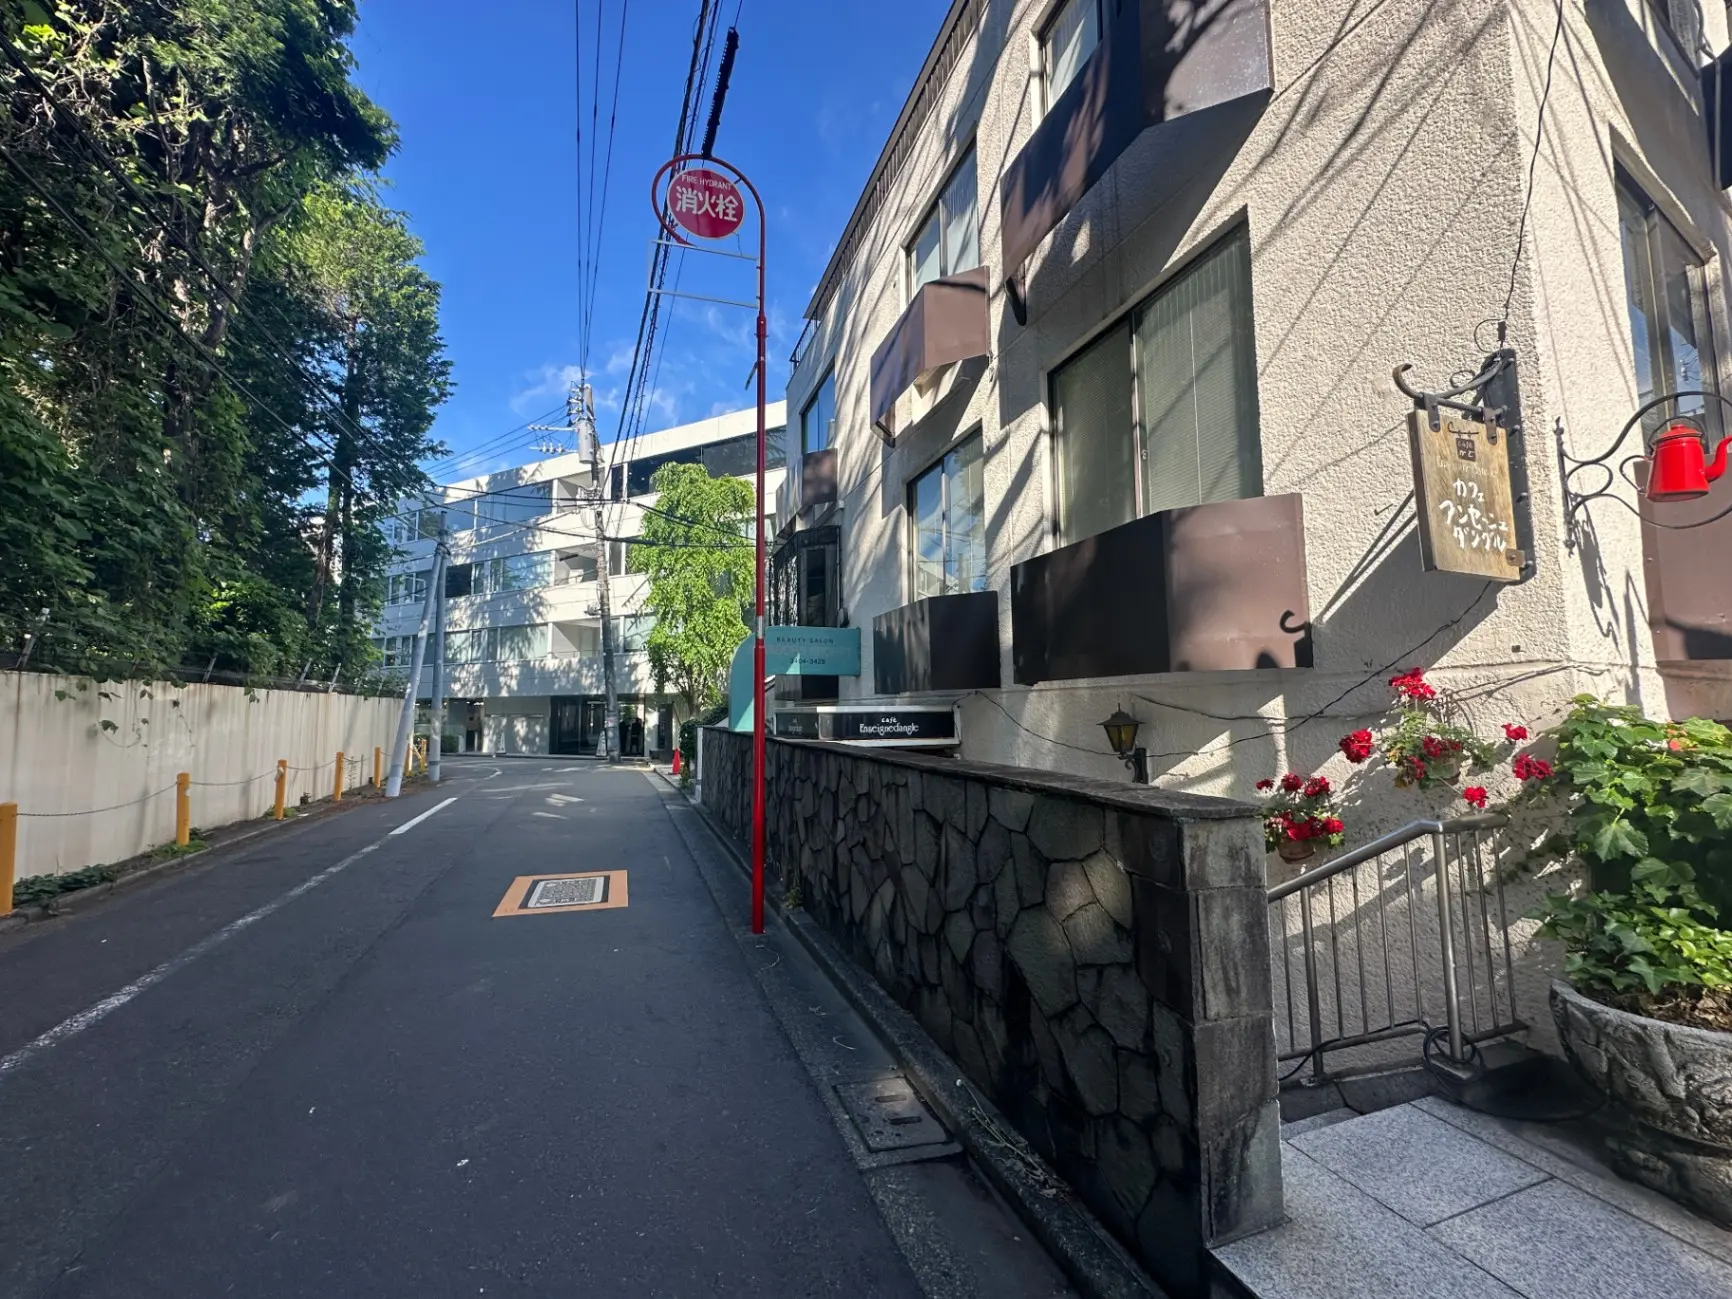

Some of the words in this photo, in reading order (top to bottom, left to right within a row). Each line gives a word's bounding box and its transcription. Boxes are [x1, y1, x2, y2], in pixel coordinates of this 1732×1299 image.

[681, 174, 698, 184] FIRE
[699, 178, 732, 191] HYDRANT
[675, 185, 739, 222] 消火栓
[1453, 478, 1484, 503] カフェ
[1453, 525, 1507, 552] ダングル
[809, 637, 834, 645] SALON
